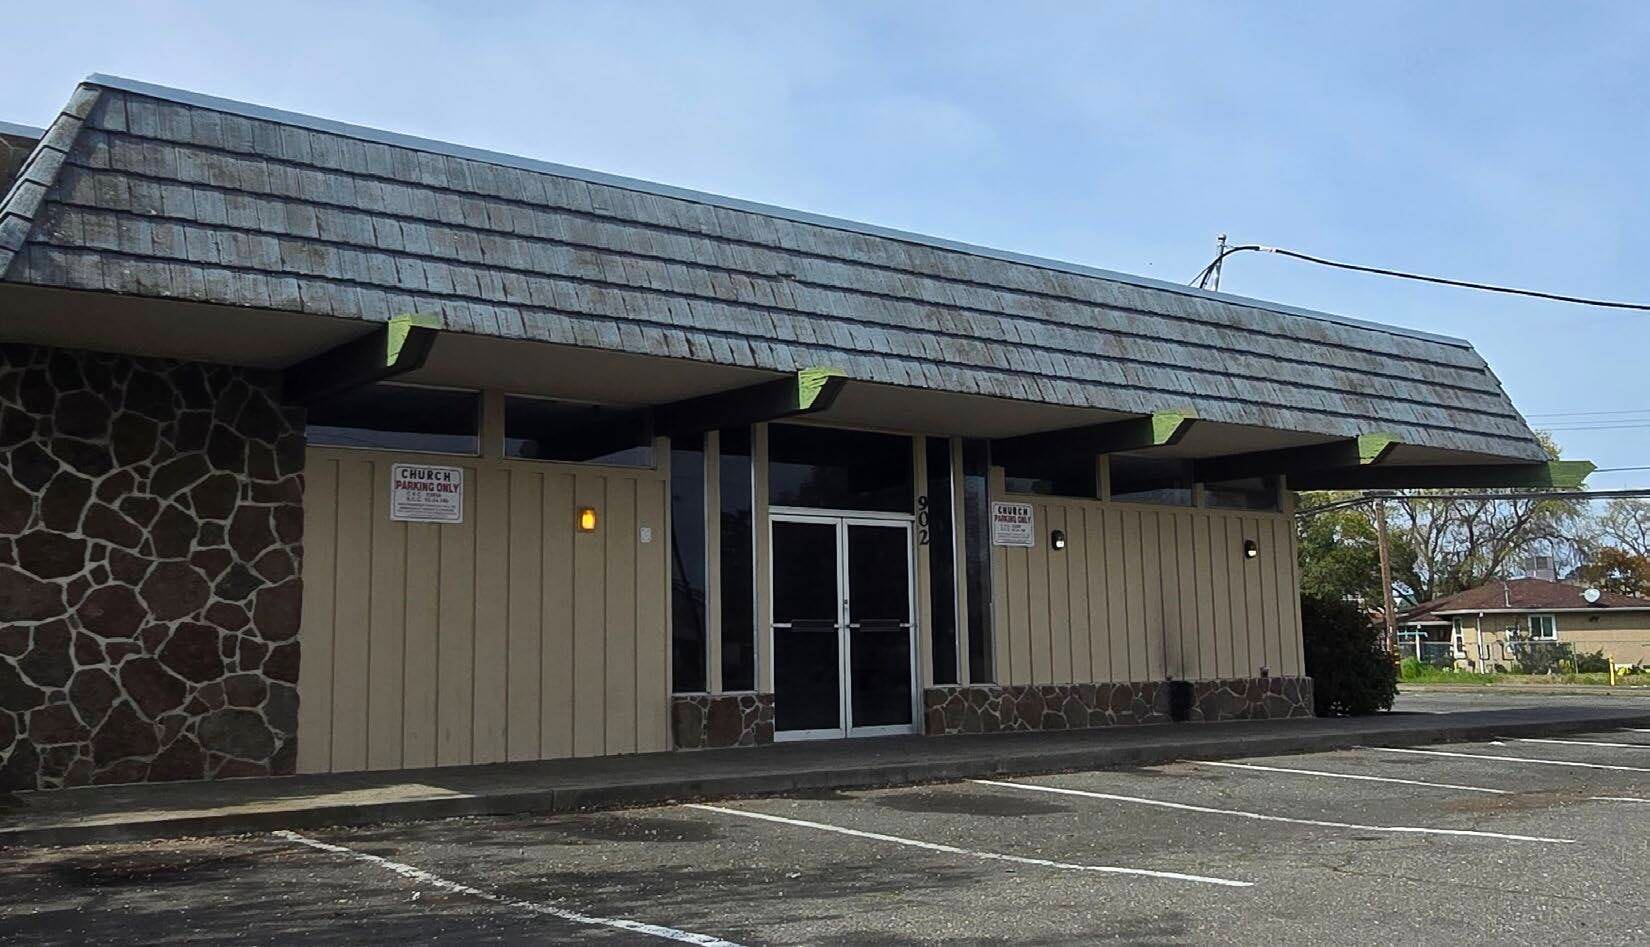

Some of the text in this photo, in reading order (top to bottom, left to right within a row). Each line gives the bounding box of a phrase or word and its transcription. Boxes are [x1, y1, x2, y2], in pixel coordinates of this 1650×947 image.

[401, 469, 451, 482] CHURCH
[395, 480, 460, 493] PARKING ONLY
[998, 505, 1028, 516] CHURCH
[918, 496, 930, 545] 902
[994, 515, 1031, 524] PARKING ONLY
